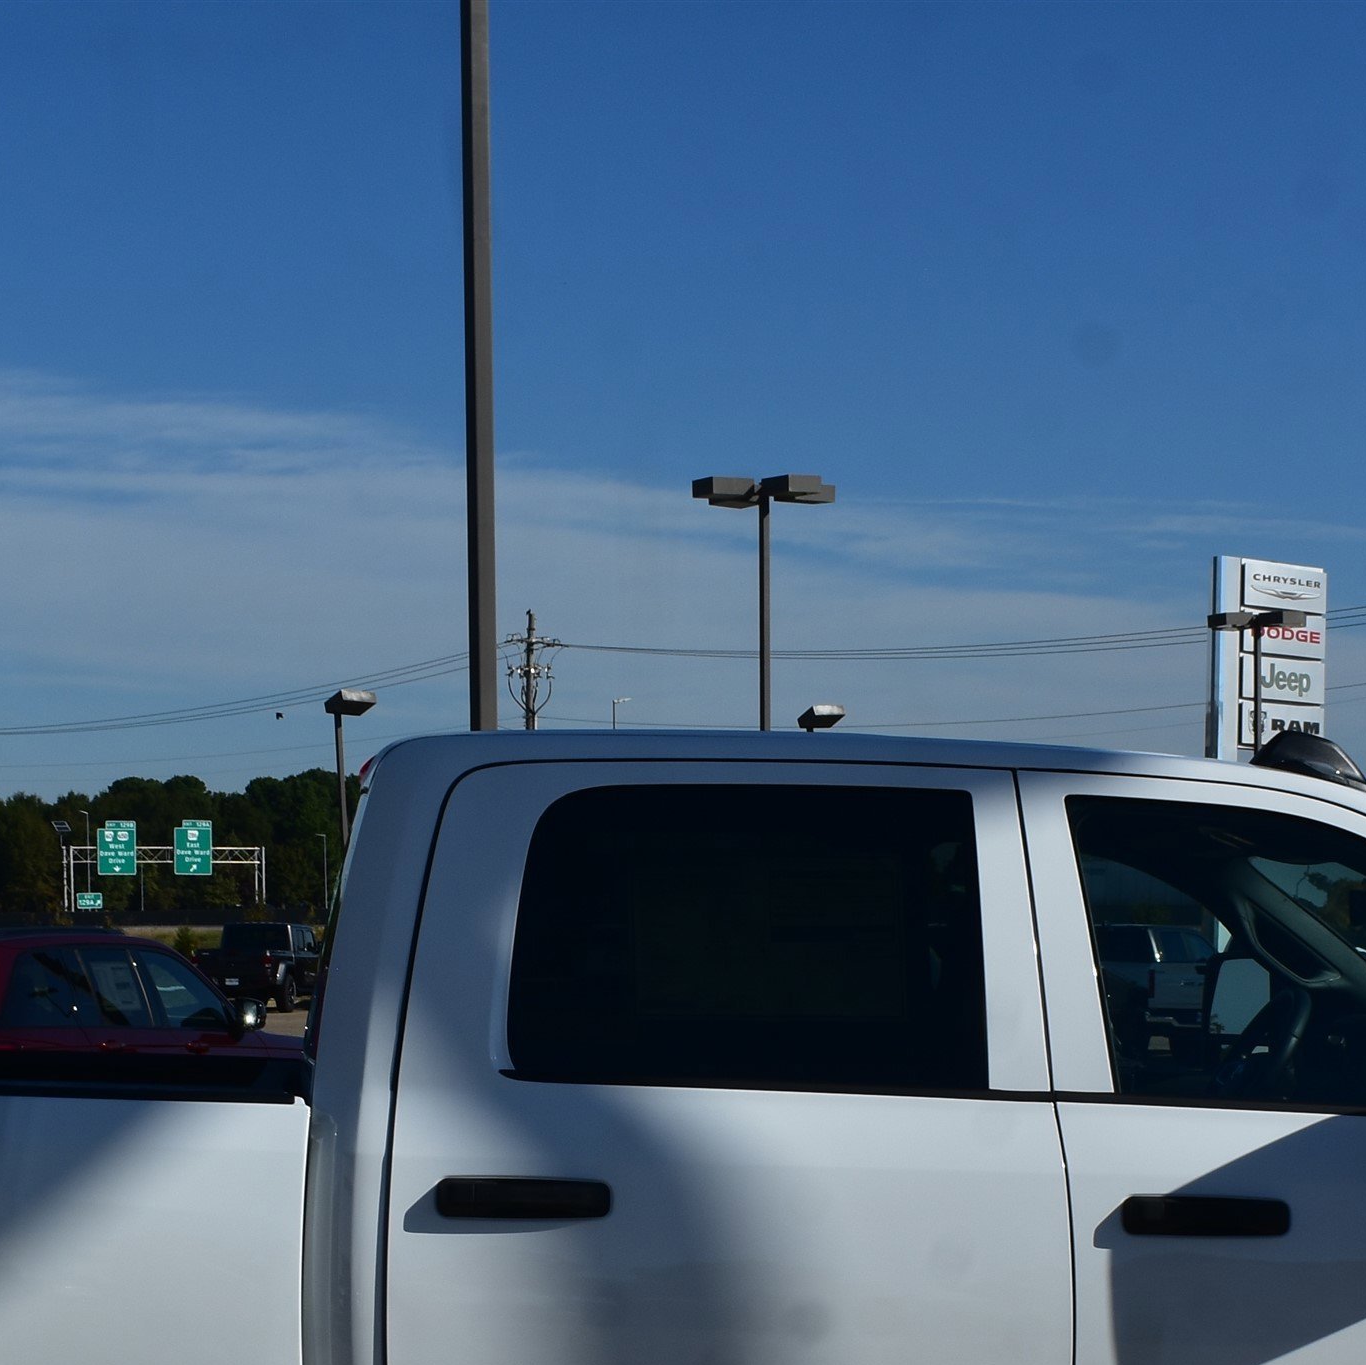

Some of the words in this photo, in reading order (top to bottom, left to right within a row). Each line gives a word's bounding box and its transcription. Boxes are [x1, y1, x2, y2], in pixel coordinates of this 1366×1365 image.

[1252, 573, 1321, 589] CHRYSLER
[1261, 663, 1311, 697] Jeep
[1271, 718, 1320, 735] RAM
